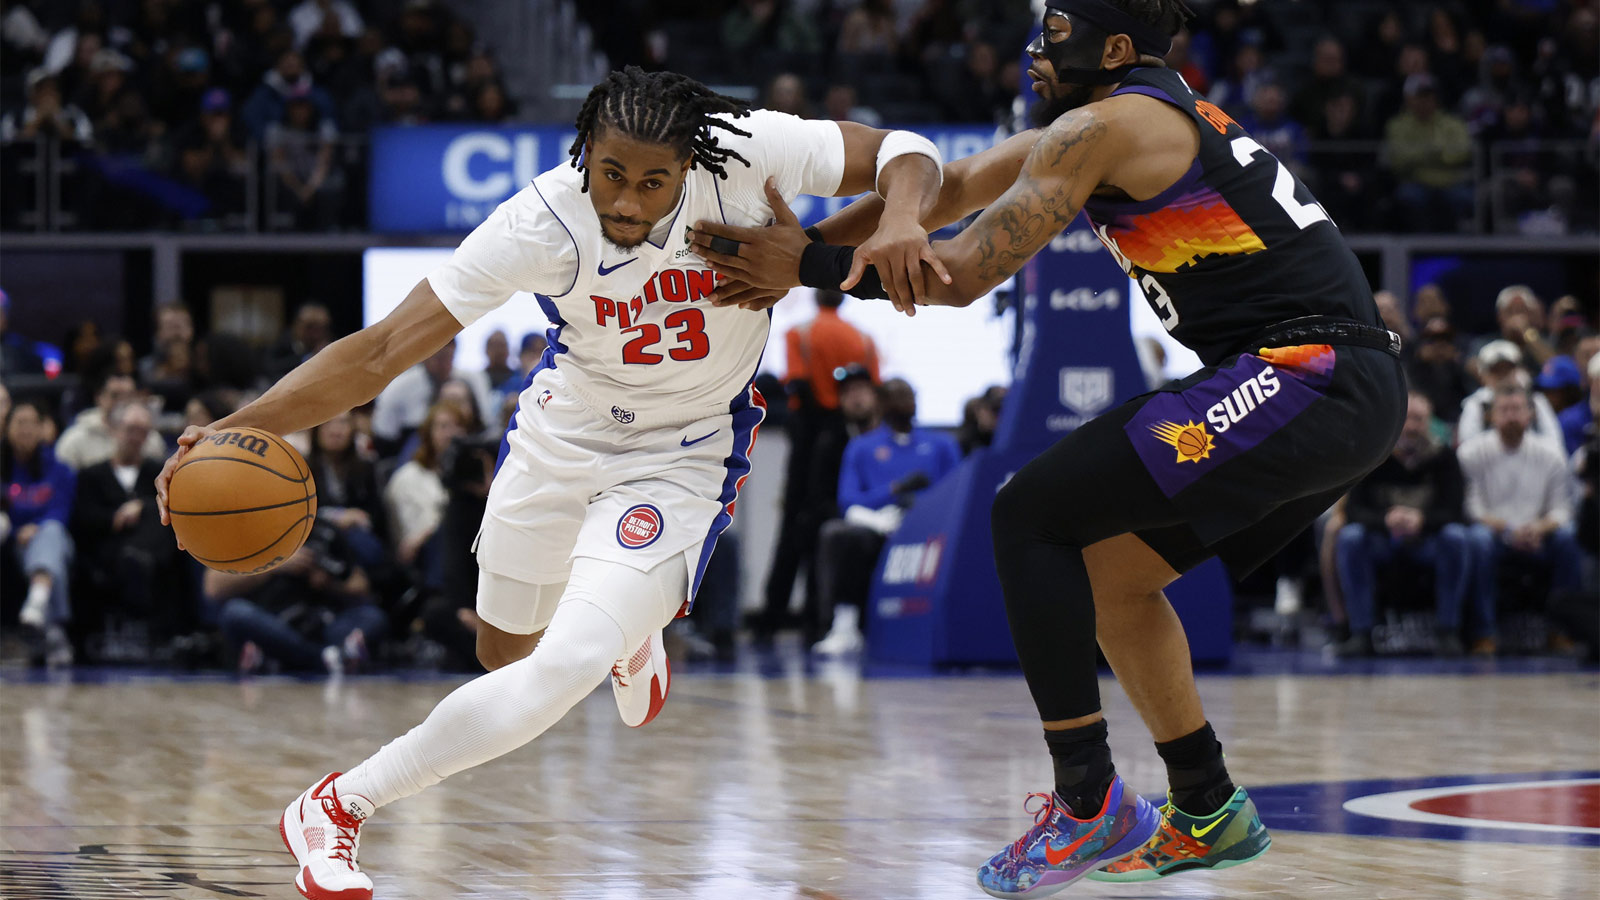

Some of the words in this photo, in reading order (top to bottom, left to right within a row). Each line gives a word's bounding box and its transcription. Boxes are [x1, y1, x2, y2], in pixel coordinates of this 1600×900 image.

[1230, 136, 1338, 230] 2
[675, 246, 693, 259] Stoc
[590, 268, 726, 329] PISTON
[620, 308, 710, 365] 23
[1206, 365, 1281, 433] SUNS
[624, 523, 650, 538] PISTONS
[629, 516, 655, 530] DETROIT
